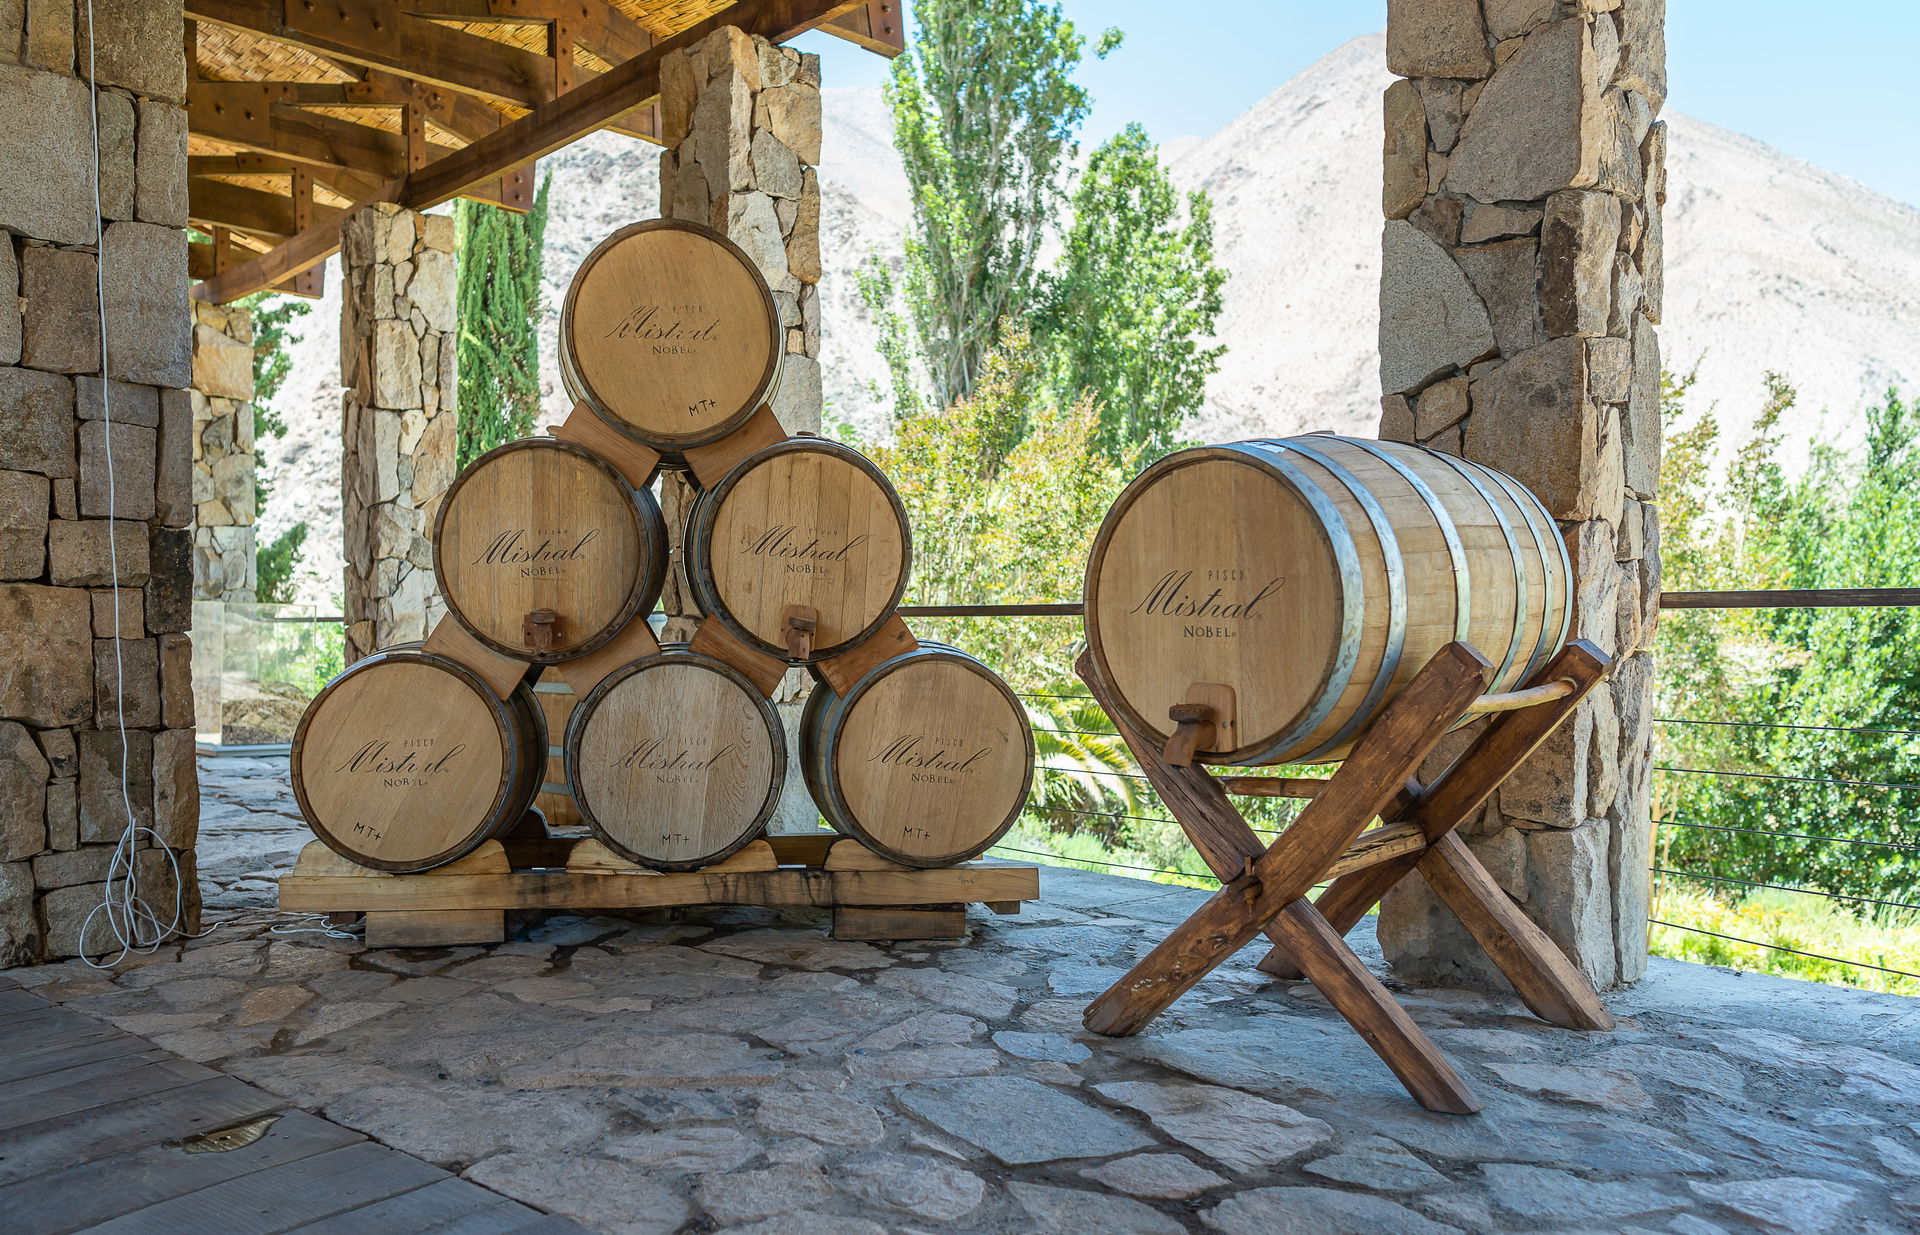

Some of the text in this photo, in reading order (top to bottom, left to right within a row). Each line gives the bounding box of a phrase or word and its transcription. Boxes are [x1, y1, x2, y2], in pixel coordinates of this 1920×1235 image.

[672, 305, 703, 314] PSCO
[472, 528, 600, 566] Mistral
[740, 524, 870, 562] Mistral
[1207, 568, 1246, 582] PISCO
[1129, 569, 1287, 621] Mistral
[610, 737, 737, 772] Mistral
[867, 734, 993, 774] Mistral
